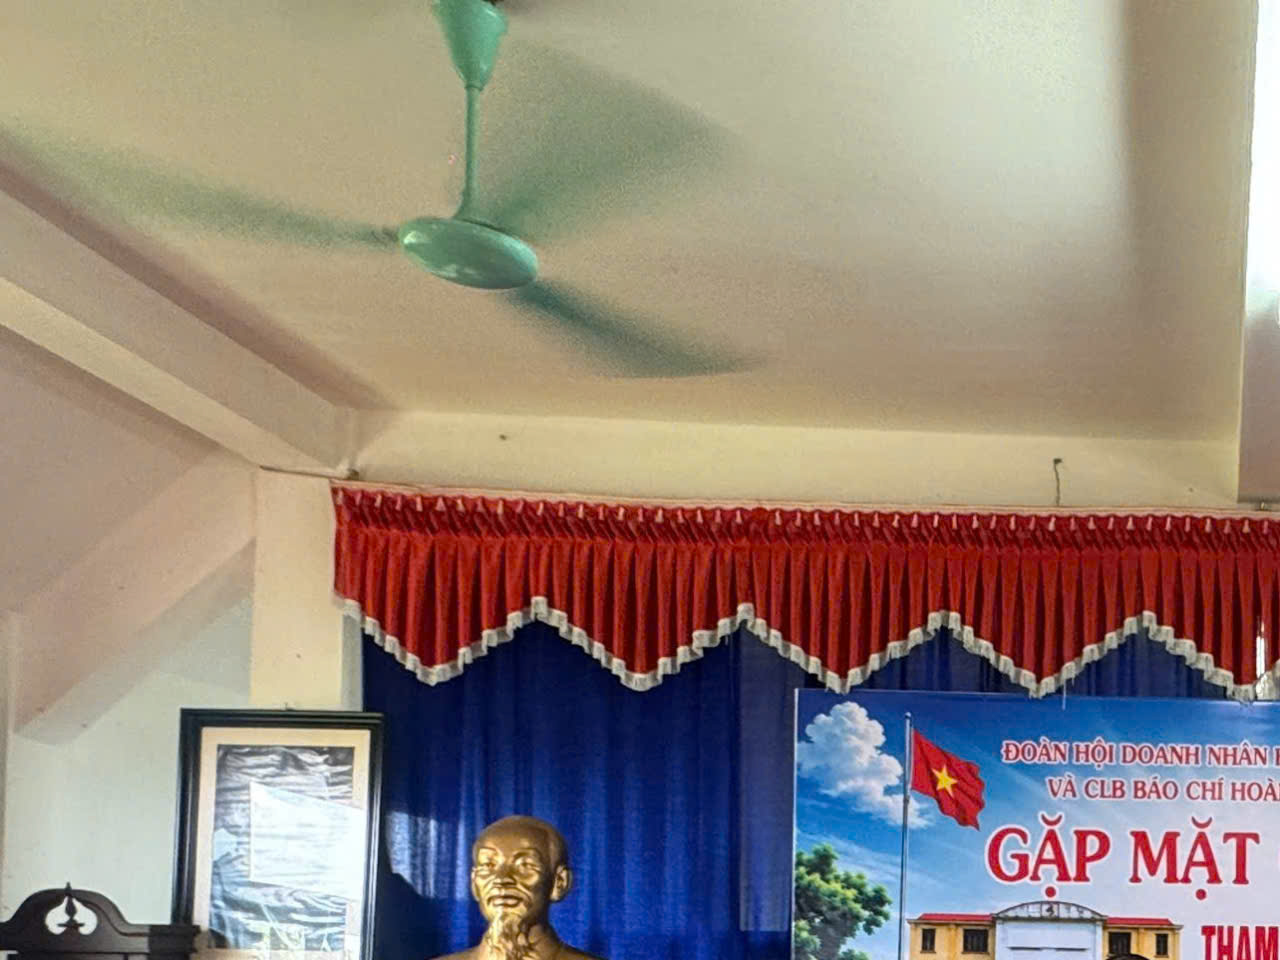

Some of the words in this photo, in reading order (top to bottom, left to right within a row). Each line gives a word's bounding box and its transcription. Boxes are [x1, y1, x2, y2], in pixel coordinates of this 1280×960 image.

[1003, 739, 1067, 763] ĐOÀN
[1075, 738, 1114, 768] HỘI
[1122, 745, 1201, 765] DOANH
[1208, 742, 1267, 766] NHÂN
[1049, 774, 1076, 798] VÀ
[1085, 779, 1126, 799] CLB
[1134, 778, 1178, 800] BÁO
[1187, 777, 1224, 801] CHÍ
[987, 813, 1111, 899] GẶP
[1130, 816, 1260, 900] MẶT
